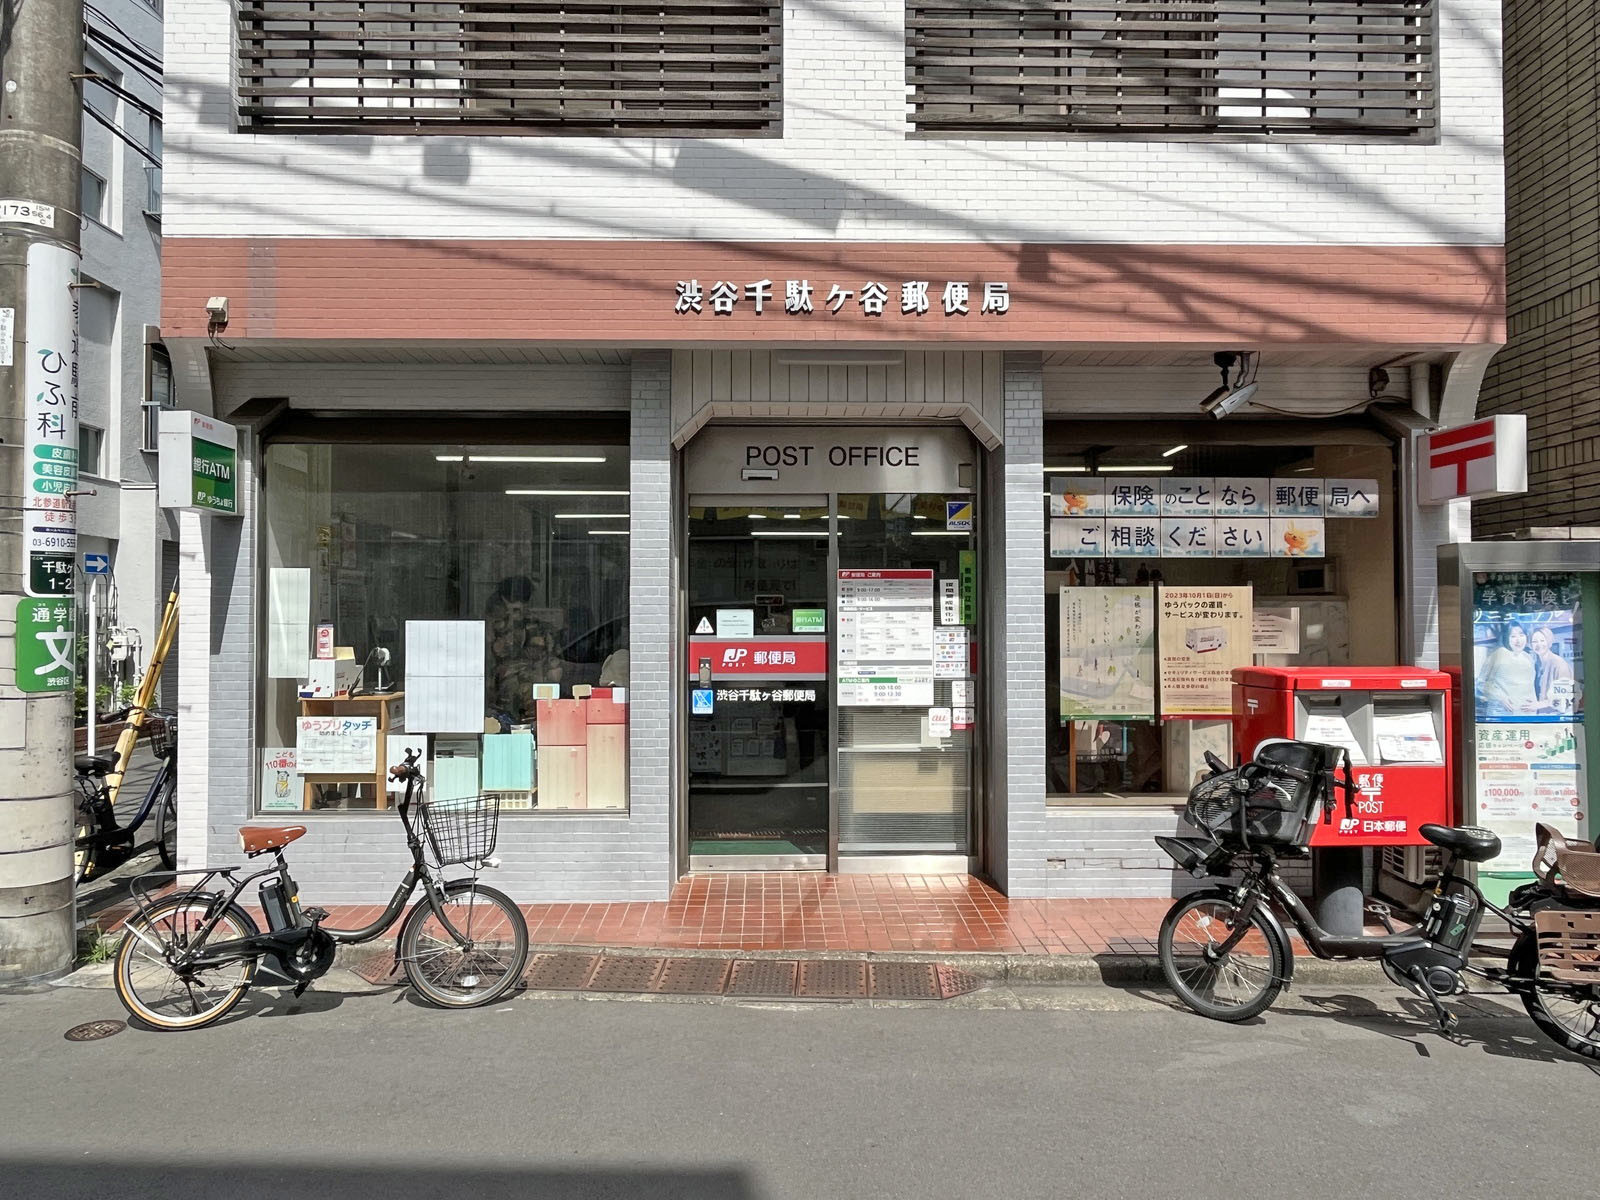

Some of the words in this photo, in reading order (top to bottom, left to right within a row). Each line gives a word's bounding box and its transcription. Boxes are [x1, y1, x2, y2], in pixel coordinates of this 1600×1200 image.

[0, 205, 31, 217] 173
[37, 348, 67, 439] ひふ科
[746, 446, 814, 466] POST
[829, 446, 919, 466] OFFICE
[193, 456, 230, 479] 銀行ATM
[753, 651, 796, 665] 郵便局
[47, 677, 70, 687] 渋谷区
[265, 759, 297, 769] 110番の
[1358, 774, 1384, 788] 郵便
[1358, 801, 1384, 814] POST
[1363, 821, 1407, 833] 日本郵便
